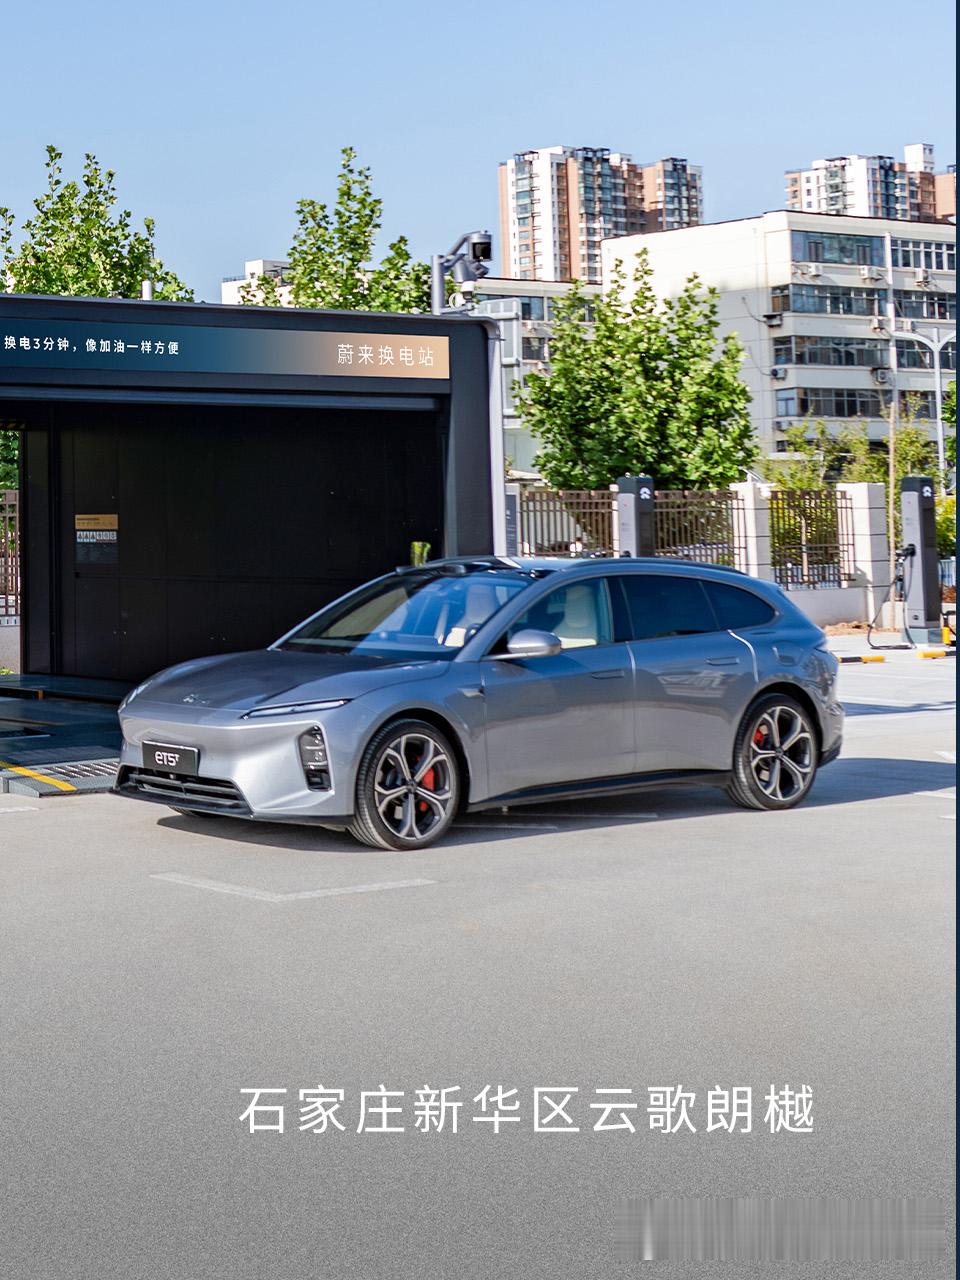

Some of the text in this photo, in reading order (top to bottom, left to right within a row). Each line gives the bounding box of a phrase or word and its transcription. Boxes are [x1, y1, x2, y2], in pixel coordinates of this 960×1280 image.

[337, 343, 434, 367] 蔚来换电站
